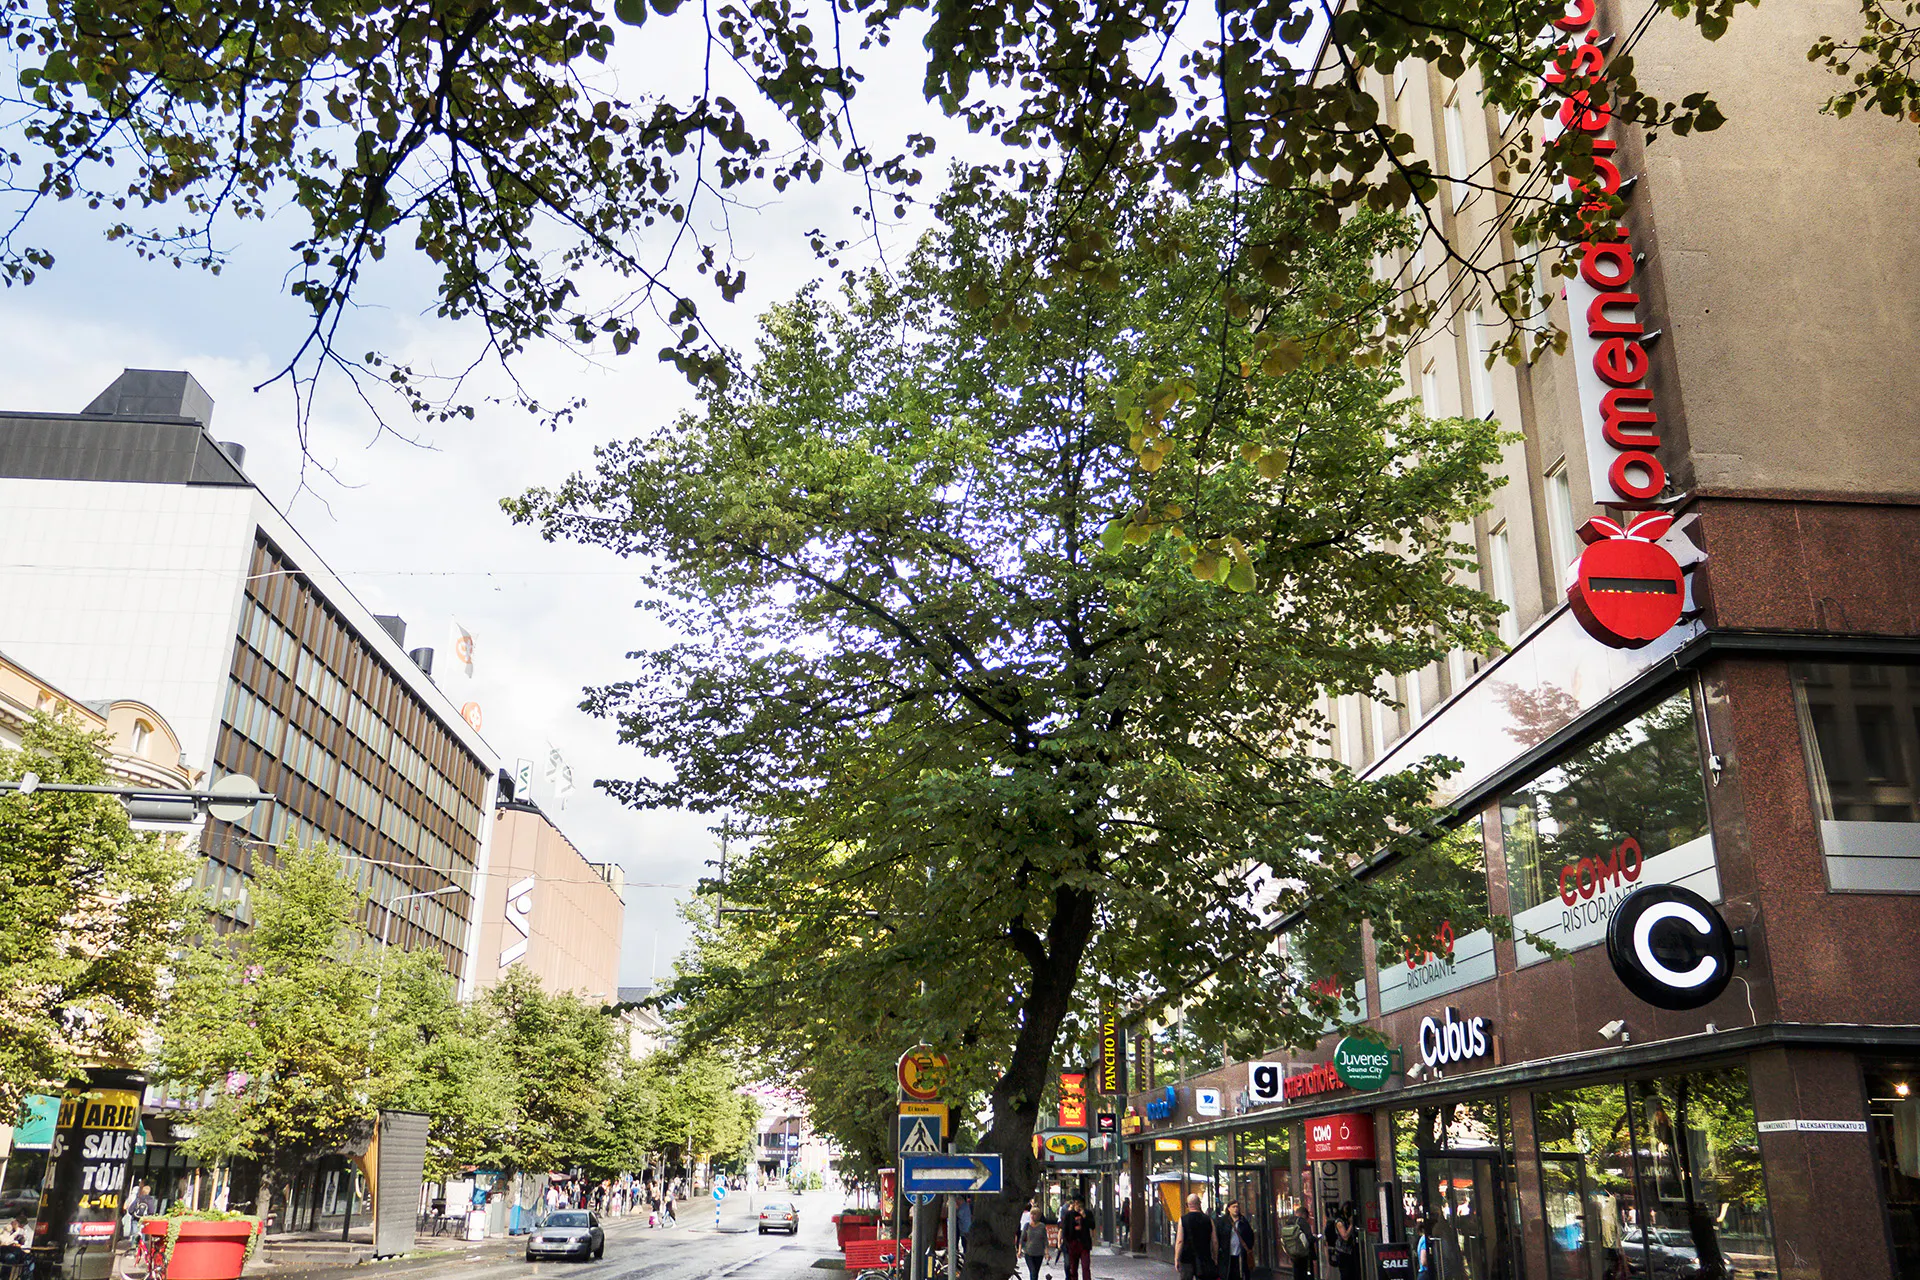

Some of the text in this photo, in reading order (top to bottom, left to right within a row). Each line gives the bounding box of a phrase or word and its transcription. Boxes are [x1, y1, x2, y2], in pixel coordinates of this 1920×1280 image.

[1559, 836, 1643, 907] COMO
[1633, 901, 1718, 988] C
[1420, 1006, 1487, 1067] Cubus
[1104, 1037, 1116, 1090] PANCHO
[1339, 1050, 1389, 1066] Juvenes
[1368, 1066, 1383, 1075] City
[1313, 1124, 1332, 1142] COMO
[1382, 1259, 1409, 1269] SALE
